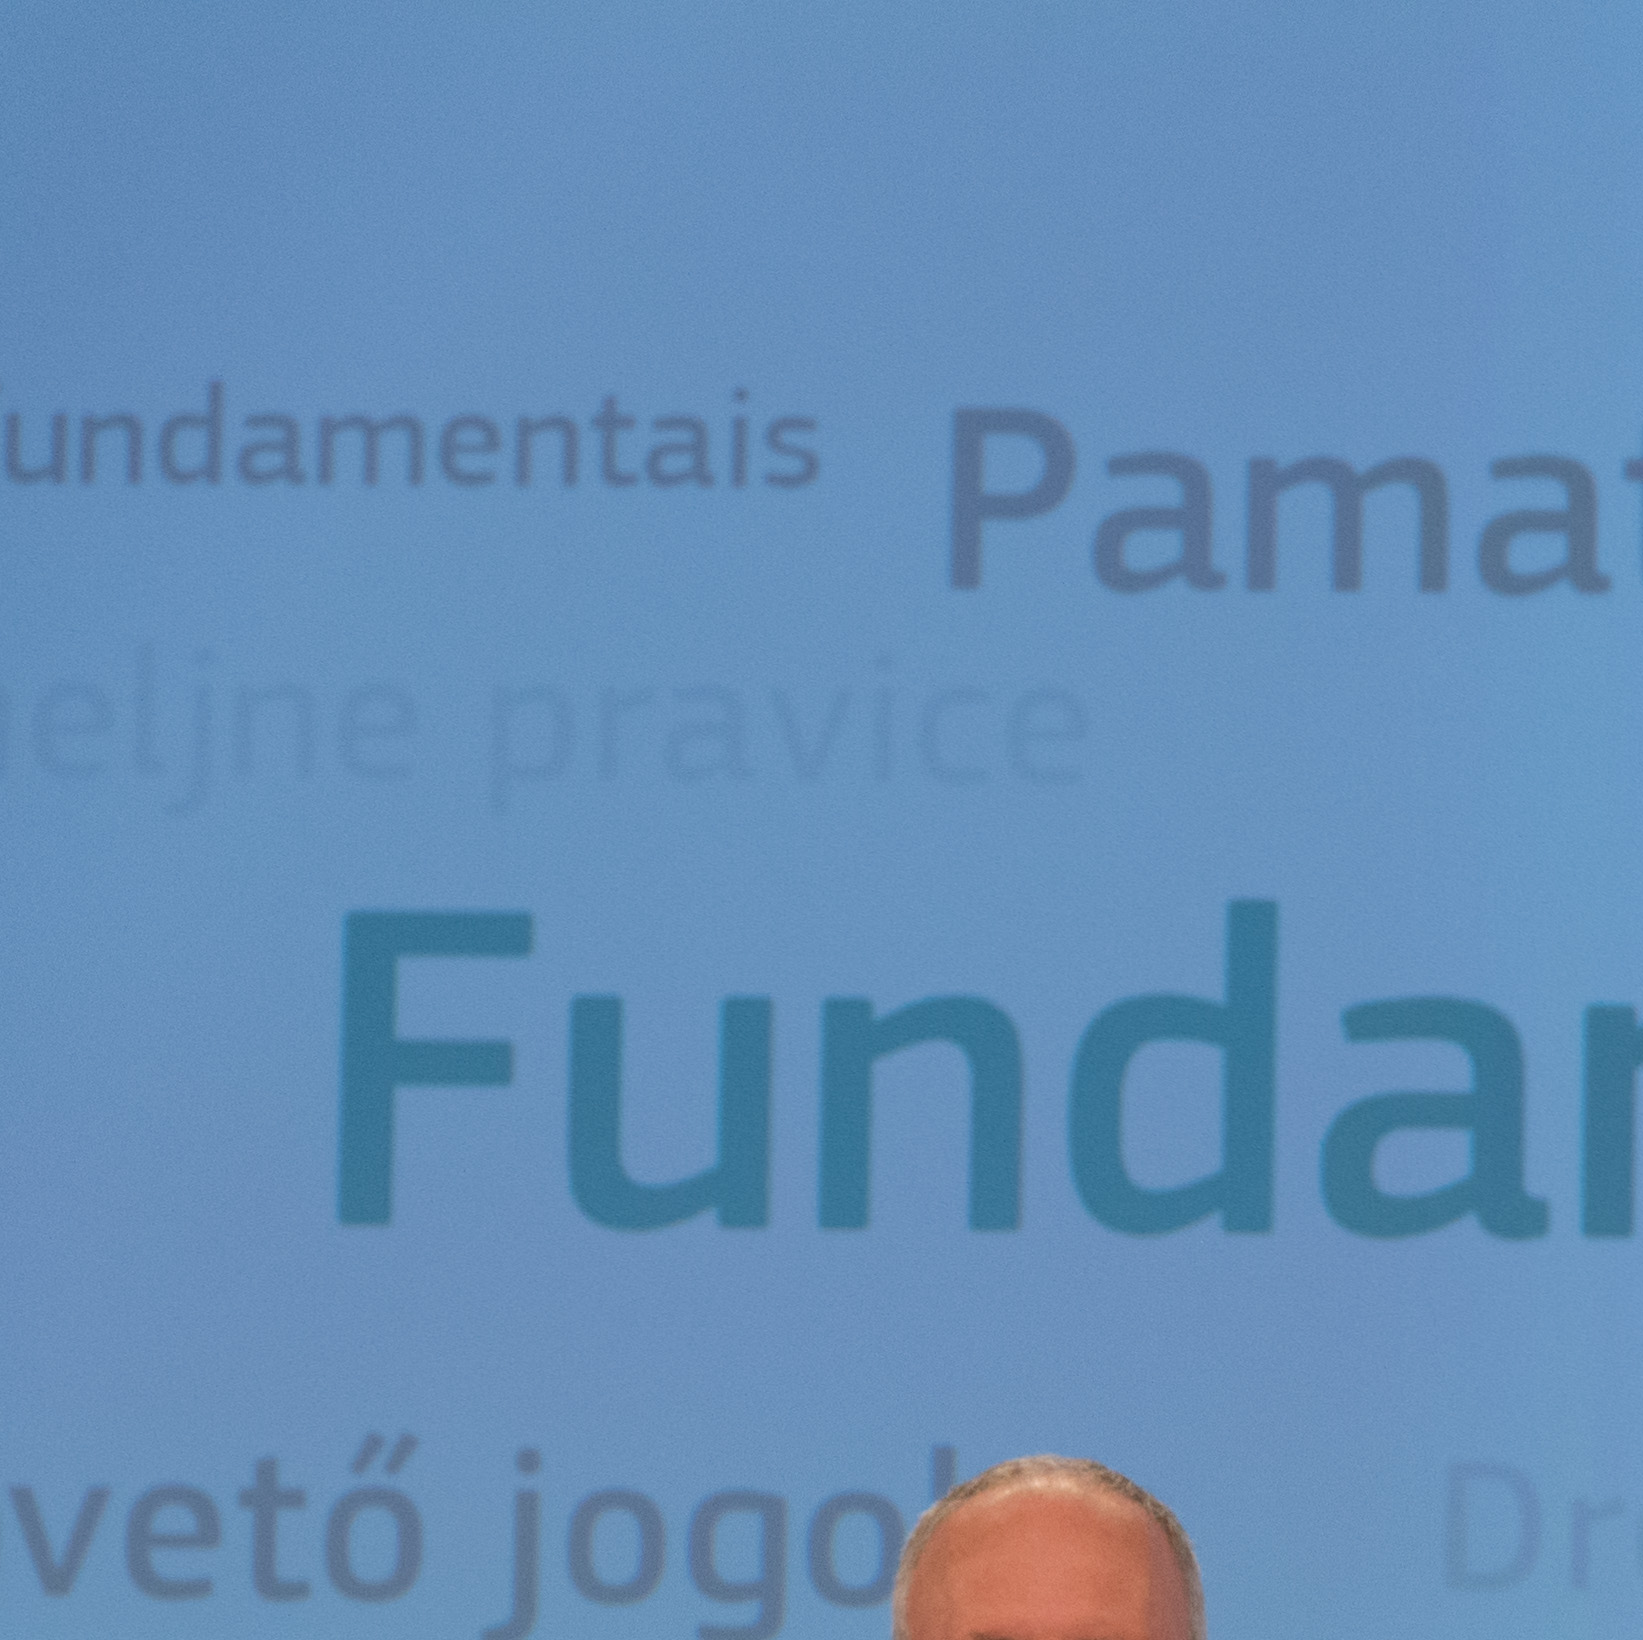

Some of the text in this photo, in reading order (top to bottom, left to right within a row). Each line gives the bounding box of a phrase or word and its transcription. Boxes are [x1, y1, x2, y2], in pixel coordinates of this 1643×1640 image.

[0, 378, 822, 491] undamentais
[0, 640, 1092, 820] eljne pravice
